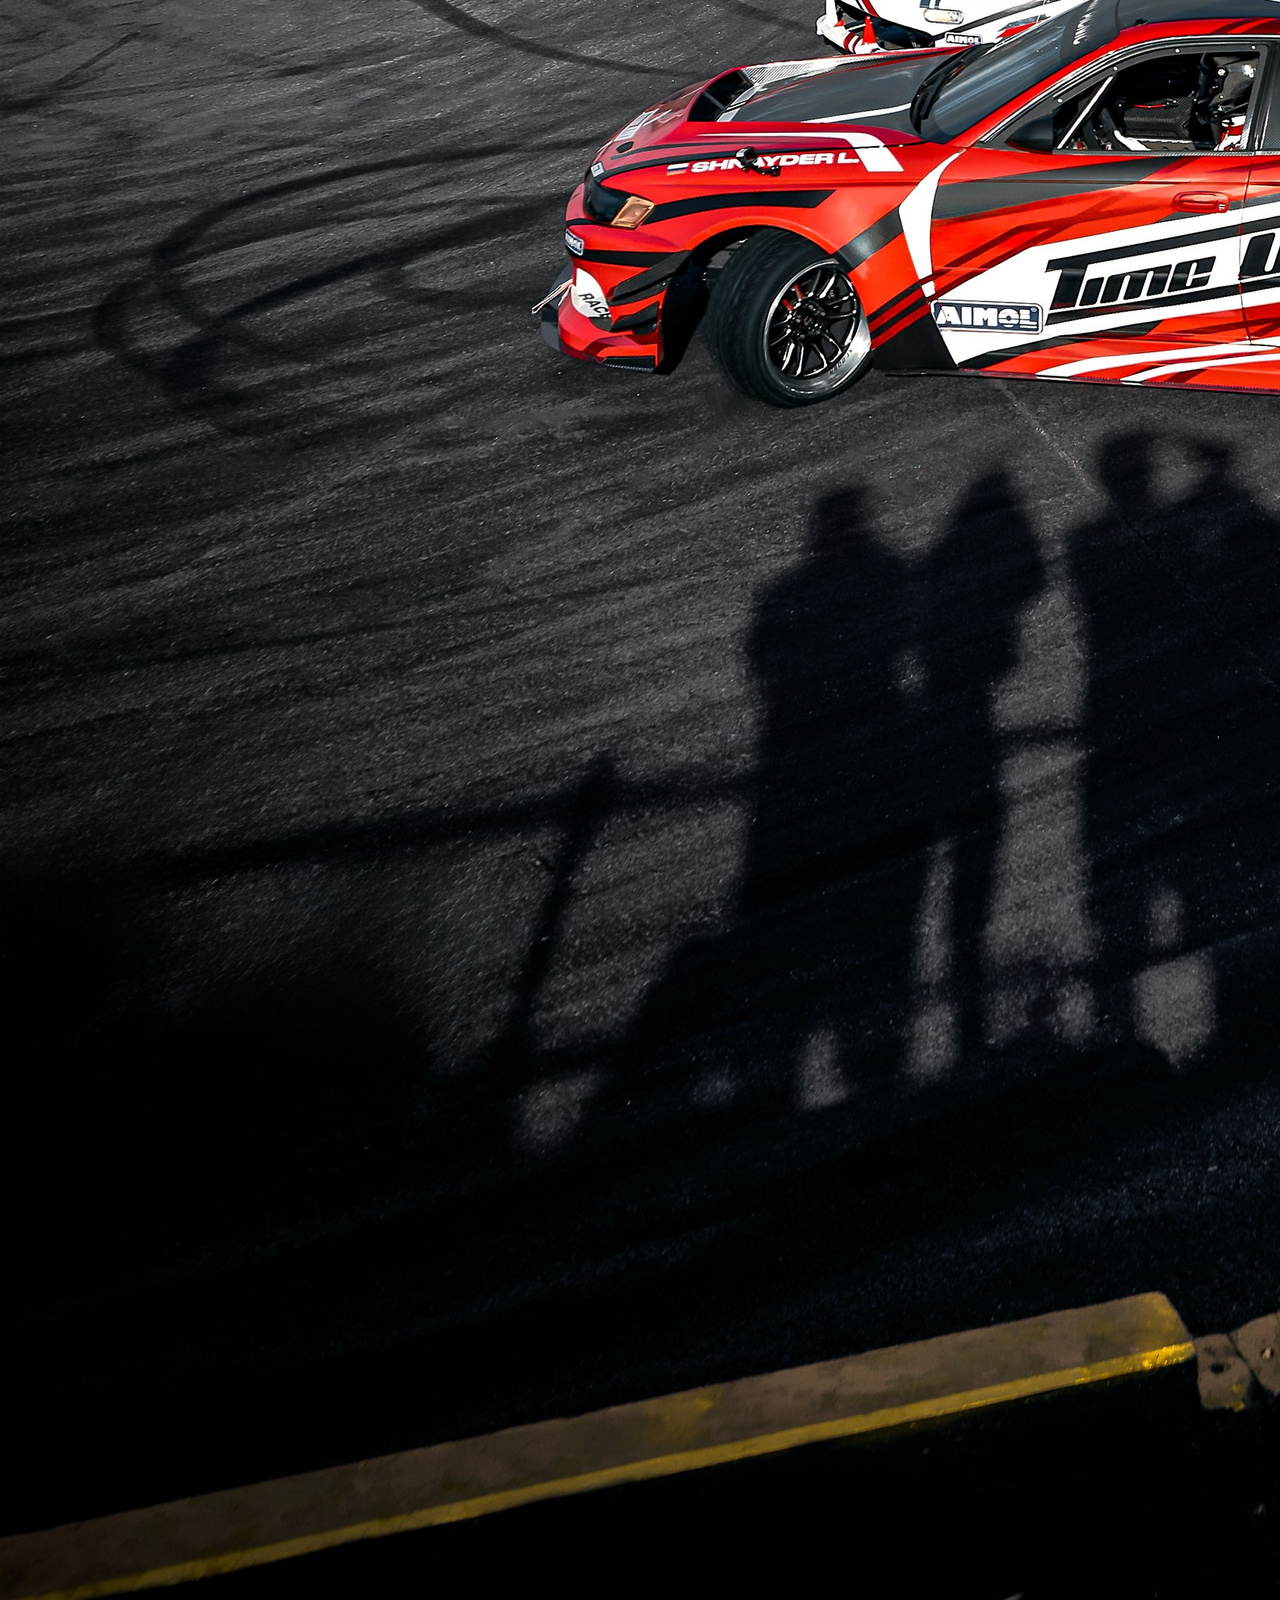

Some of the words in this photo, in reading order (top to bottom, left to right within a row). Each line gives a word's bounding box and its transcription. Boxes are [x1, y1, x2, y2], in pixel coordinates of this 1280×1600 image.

[946, 33, 981, 45] AIMOL
[837, 152, 860, 165] L.
[935, 305, 1038, 329] AIMOL
